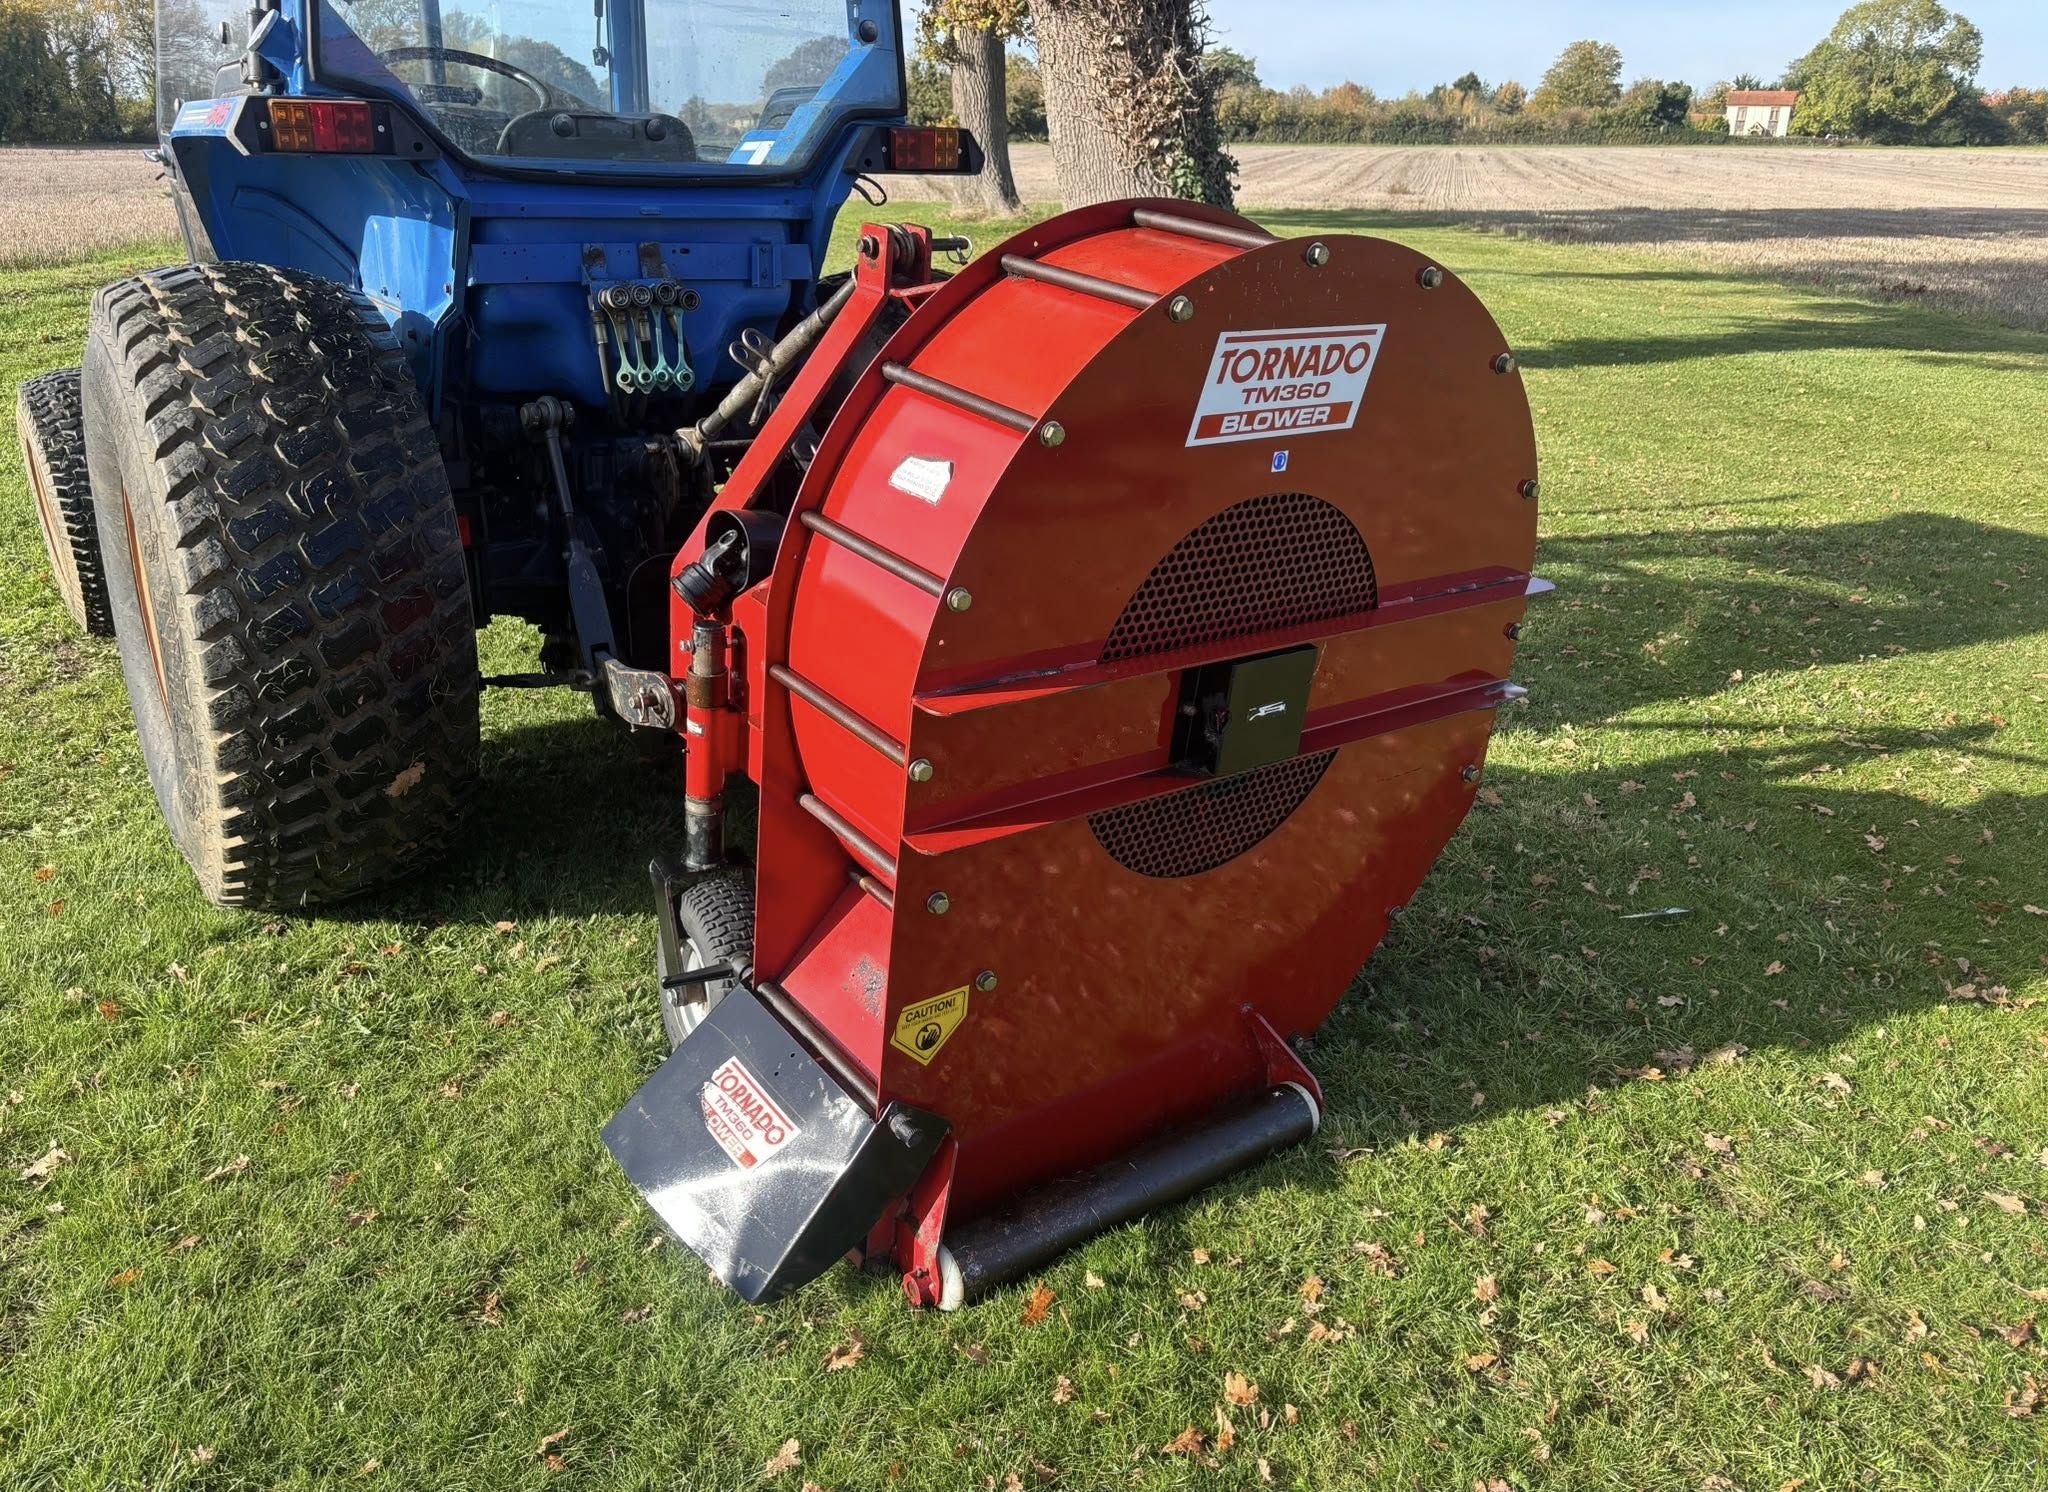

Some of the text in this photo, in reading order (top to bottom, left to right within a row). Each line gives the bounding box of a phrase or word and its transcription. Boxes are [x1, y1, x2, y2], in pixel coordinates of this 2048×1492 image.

[1216, 342, 1371, 384] TORNADO
[1242, 382, 1331, 404] TM360
[1219, 407, 1330, 434] BLOWER
[905, 997, 956, 1022] CAUTION!
[715, 1067, 785, 1145] TORNADO
[715, 1094, 753, 1140] TM360
